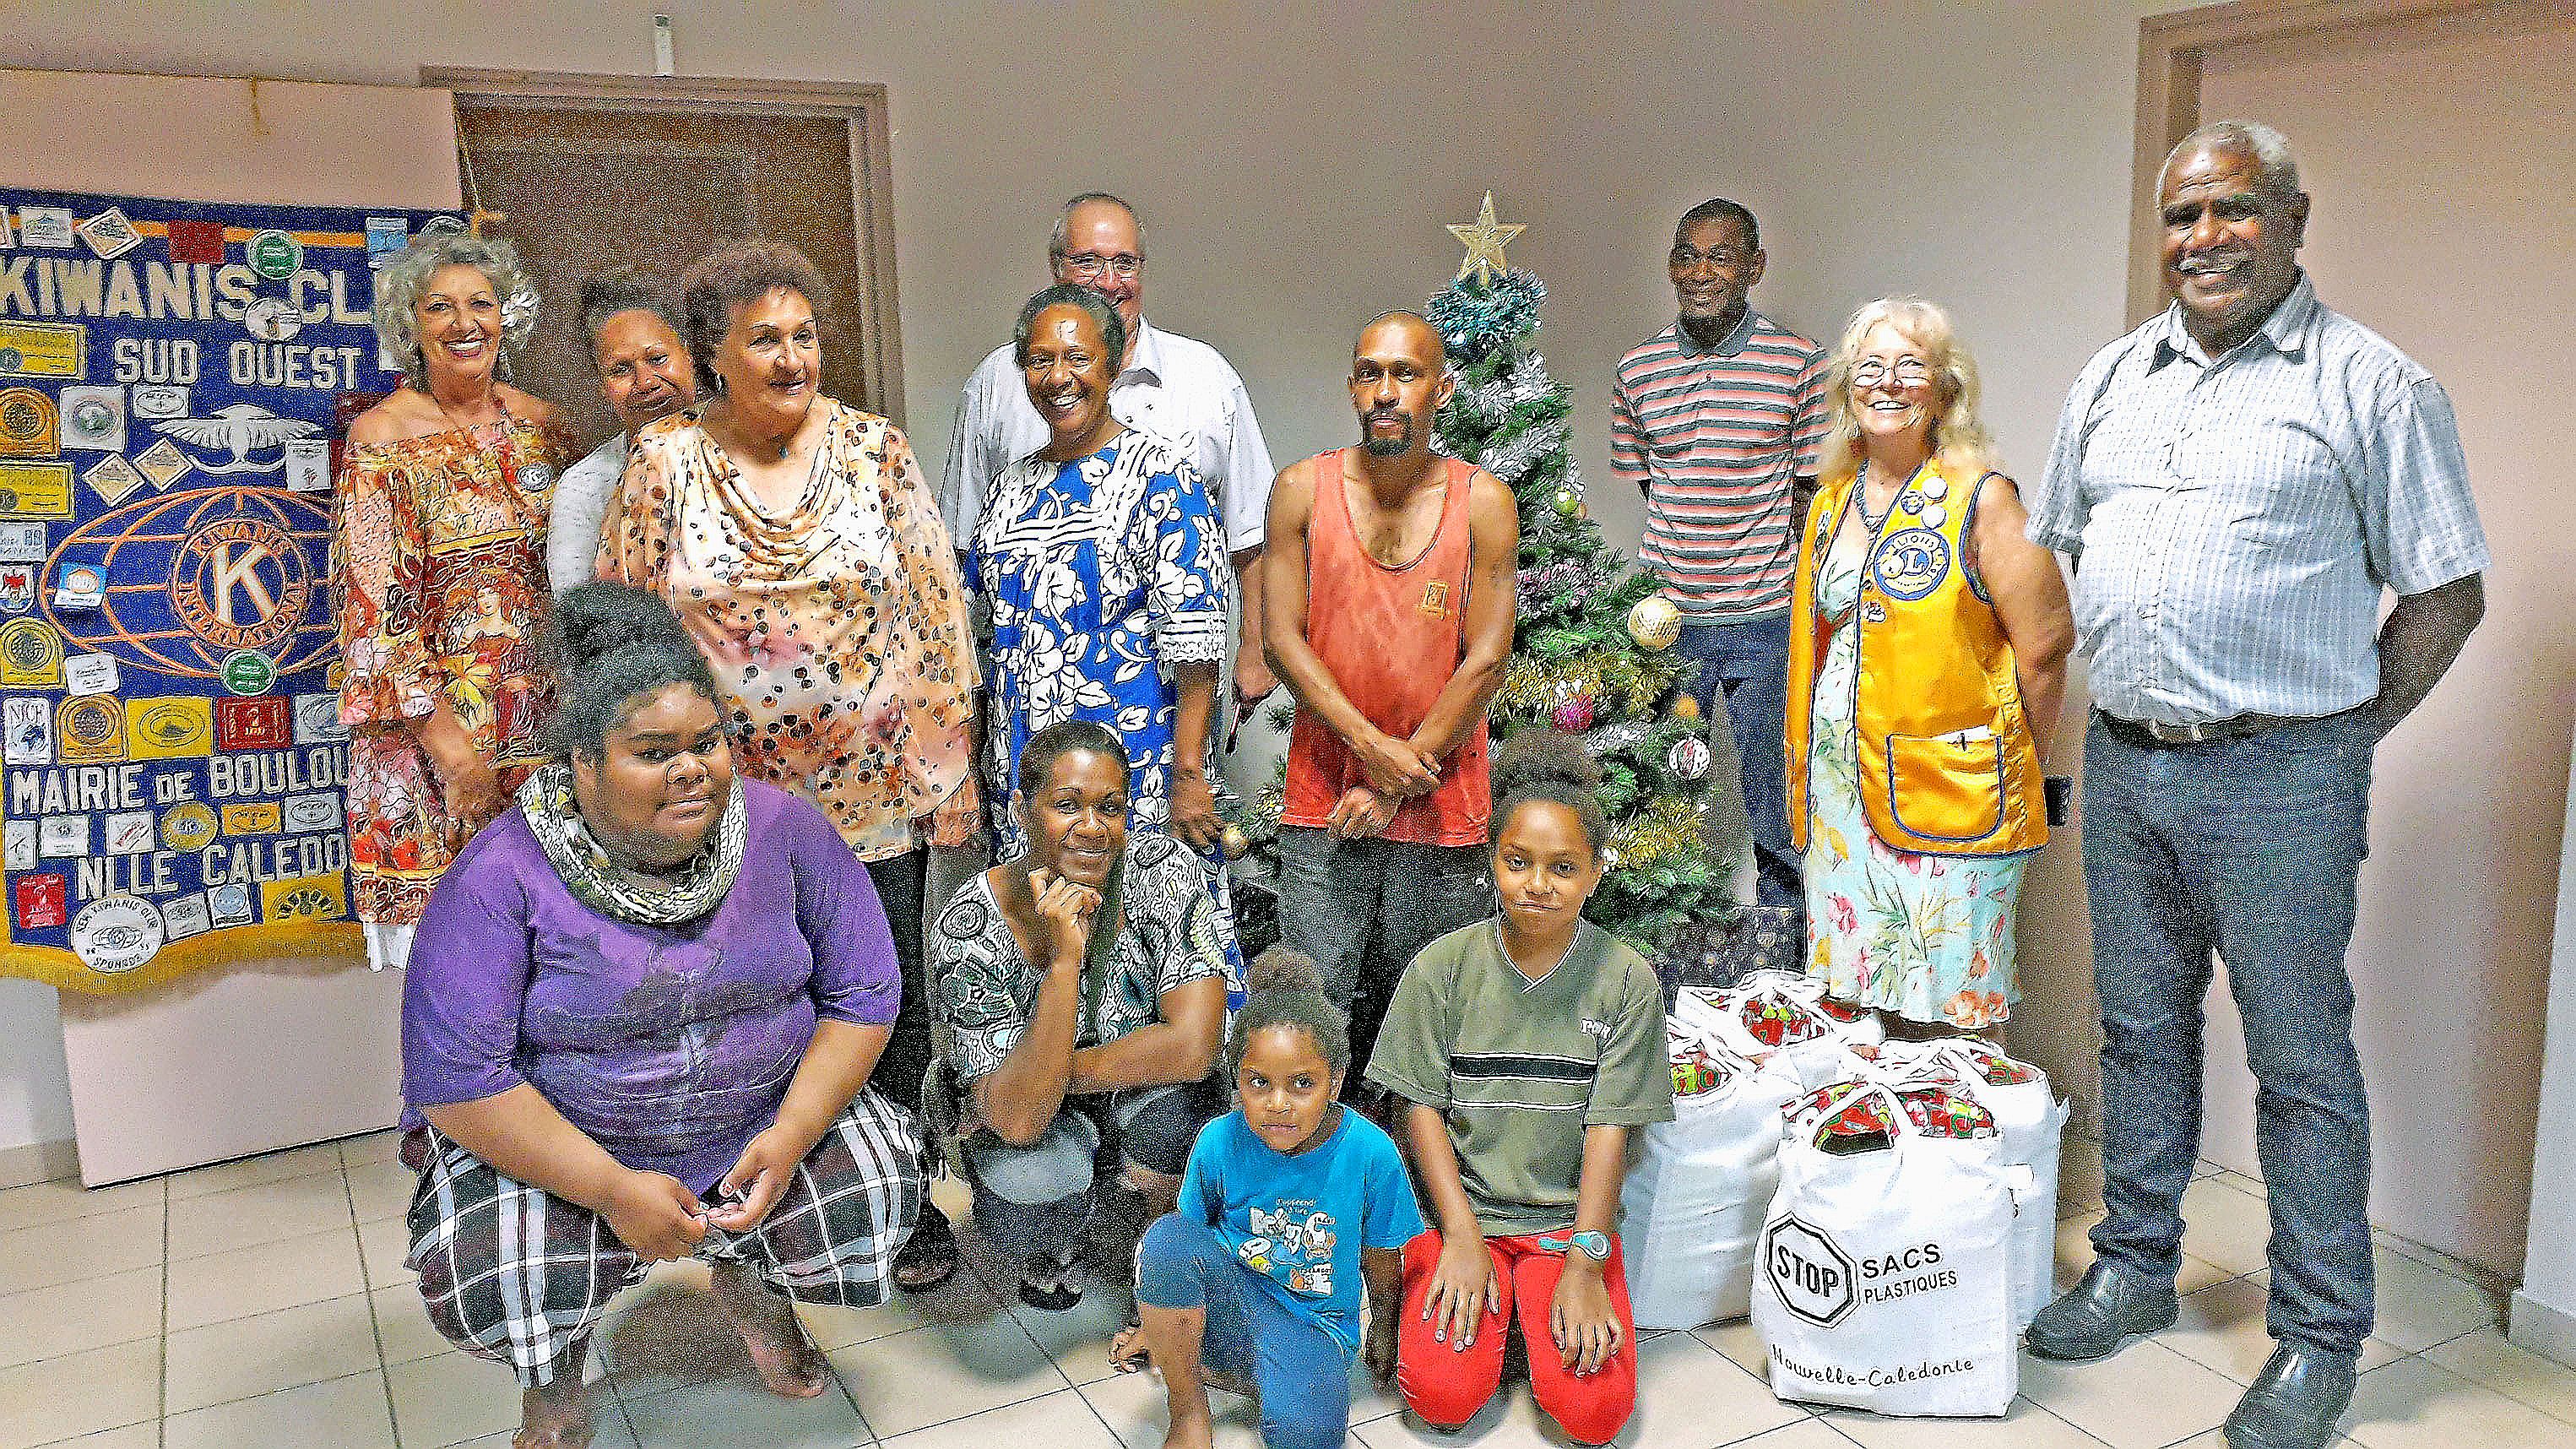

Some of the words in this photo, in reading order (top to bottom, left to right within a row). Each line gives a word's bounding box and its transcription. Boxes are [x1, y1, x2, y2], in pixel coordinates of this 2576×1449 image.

[0, 256, 257, 322] KIWANIS
[114, 338, 200, 385] SUD
[230, 341, 362, 389] OUEST
[189, 521, 292, 558] KIWANIS
[1904, 549, 1925, 574] L
[211, 543, 277, 623] K
[12, 762, 144, 816] MAIRIE
[155, 770, 195, 803] DE
[209, 746, 349, 798] BOULOU
[77, 850, 179, 900] NLLE
[201, 833, 348, 887] CALEDO
[1776, 1245, 1840, 1298] STOP
[1862, 1244, 1941, 1279] SACS
[1864, 1270, 1958, 1304] PLASTIQUES
